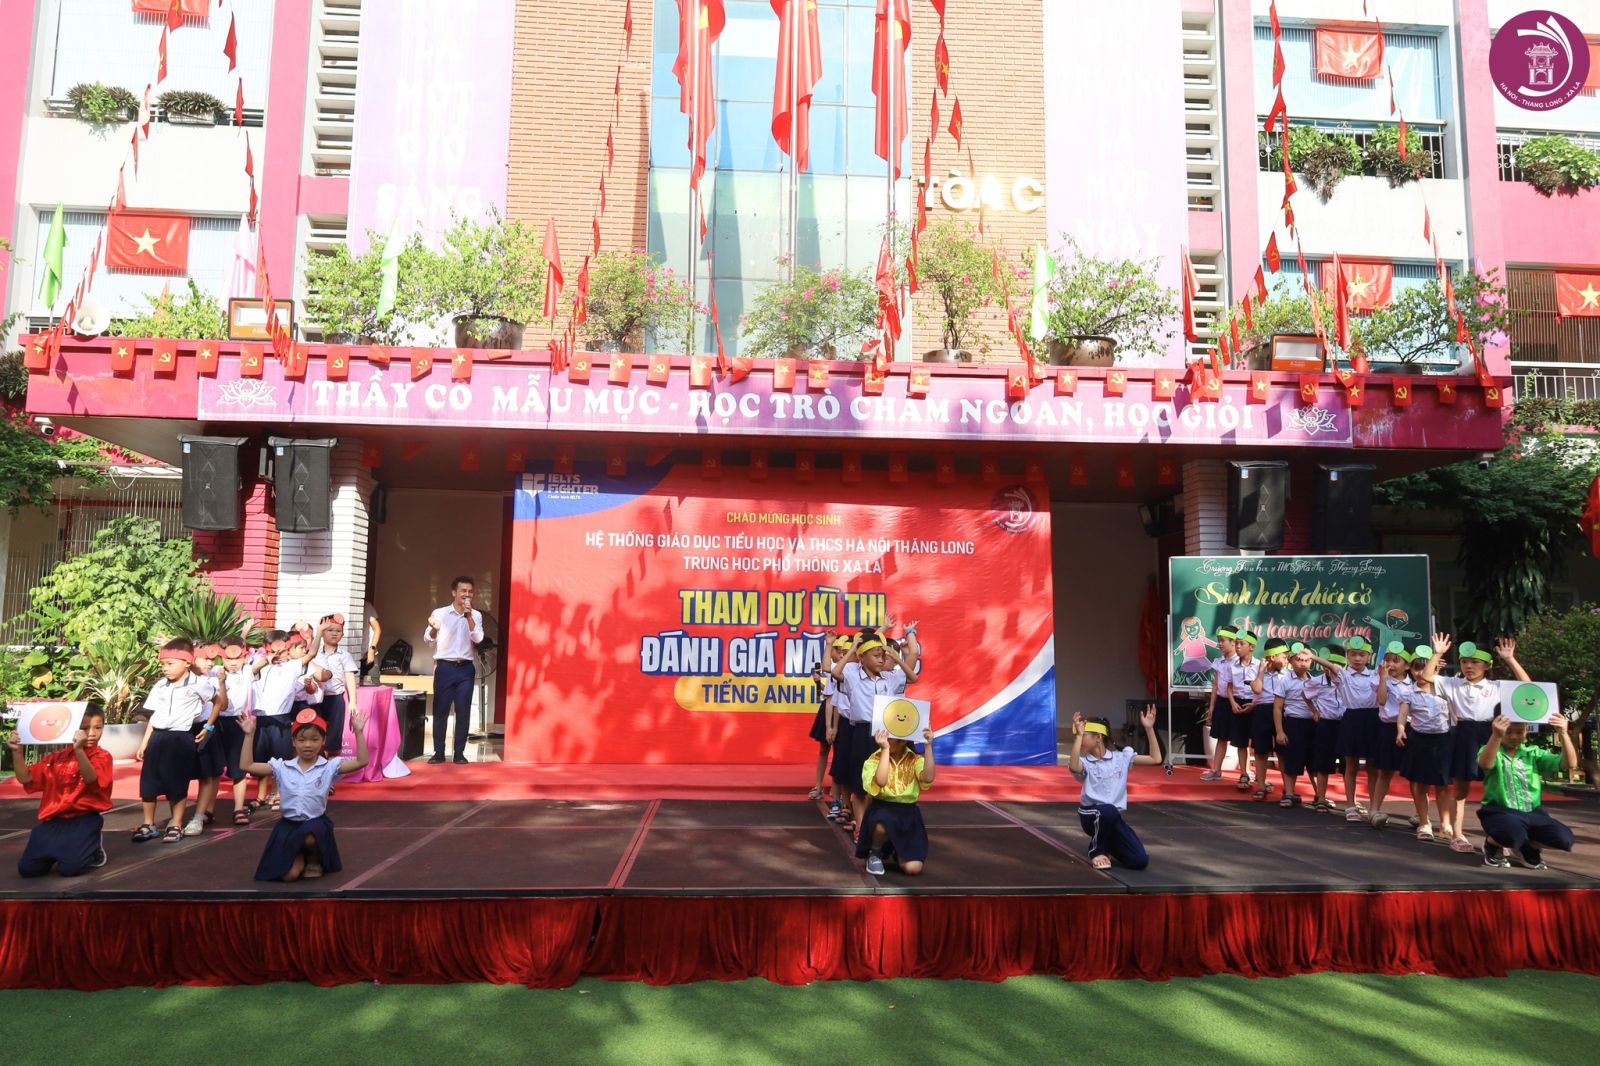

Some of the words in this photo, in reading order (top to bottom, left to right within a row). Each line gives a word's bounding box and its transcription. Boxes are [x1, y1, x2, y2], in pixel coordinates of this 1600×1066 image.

[918, 168, 1004, 211] TÒA
[1011, 175, 1044, 213] C
[312, 368, 415, 409] THẦY
[492, 373, 573, 413] MẪU
[583, 385, 660, 422] MỰC
[687, 390, 761, 424] HỌC
[769, 387, 840, 421] TRÒ
[1103, 401, 1172, 434] HỌC
[1180, 395, 1254, 429] GIỎI
[548, 473, 581, 483] IELTS
[726, 510, 756, 523] CHÀO
[758, 511, 790, 525] MỪNG
[815, 513, 841, 526] SINH
[585, 530, 604, 549] HỆ
[608, 530, 654, 548] THỐNG
[657, 532, 690, 548] GIÁO
[693, 535, 721, 550] DỤC
[724, 532, 753, 549] TIỂU
[756, 536, 785, 553] HỌC
[787, 535, 805, 551] VÀ
[809, 537, 843, 552] THCS
[845, 536, 865, 552] HÀ
[867, 536, 891, 553] NỘI
[894, 538, 938, 554] THĂNG
[941, 541, 975, 555] LONG
[683, 555, 729, 570] TRUNG
[732, 557, 760, 573] HỌC
[763, 554, 791, 572] PHỔ
[794, 556, 839, 573] THÔNG
[842, 559, 862, 574] XA
[1195, 577, 1252, 605] Sinh
[1253, 576, 1301, 608] hoạt
[1347, 582, 1373, 606] cờ
[679, 589, 760, 626] THAM
[767, 588, 807, 632] DỰ
[810, 585, 841, 627] KÌ
[844, 591, 887, 628] THI
[1266, 616, 1299, 638] toàn
[1300, 622, 1332, 643] giao
[640, 629, 723, 676] ĐÁNH
[728, 631, 779, 676] GIÁ
[701, 678, 759, 705] TIẾNG
[765, 684, 809, 705] ANH
